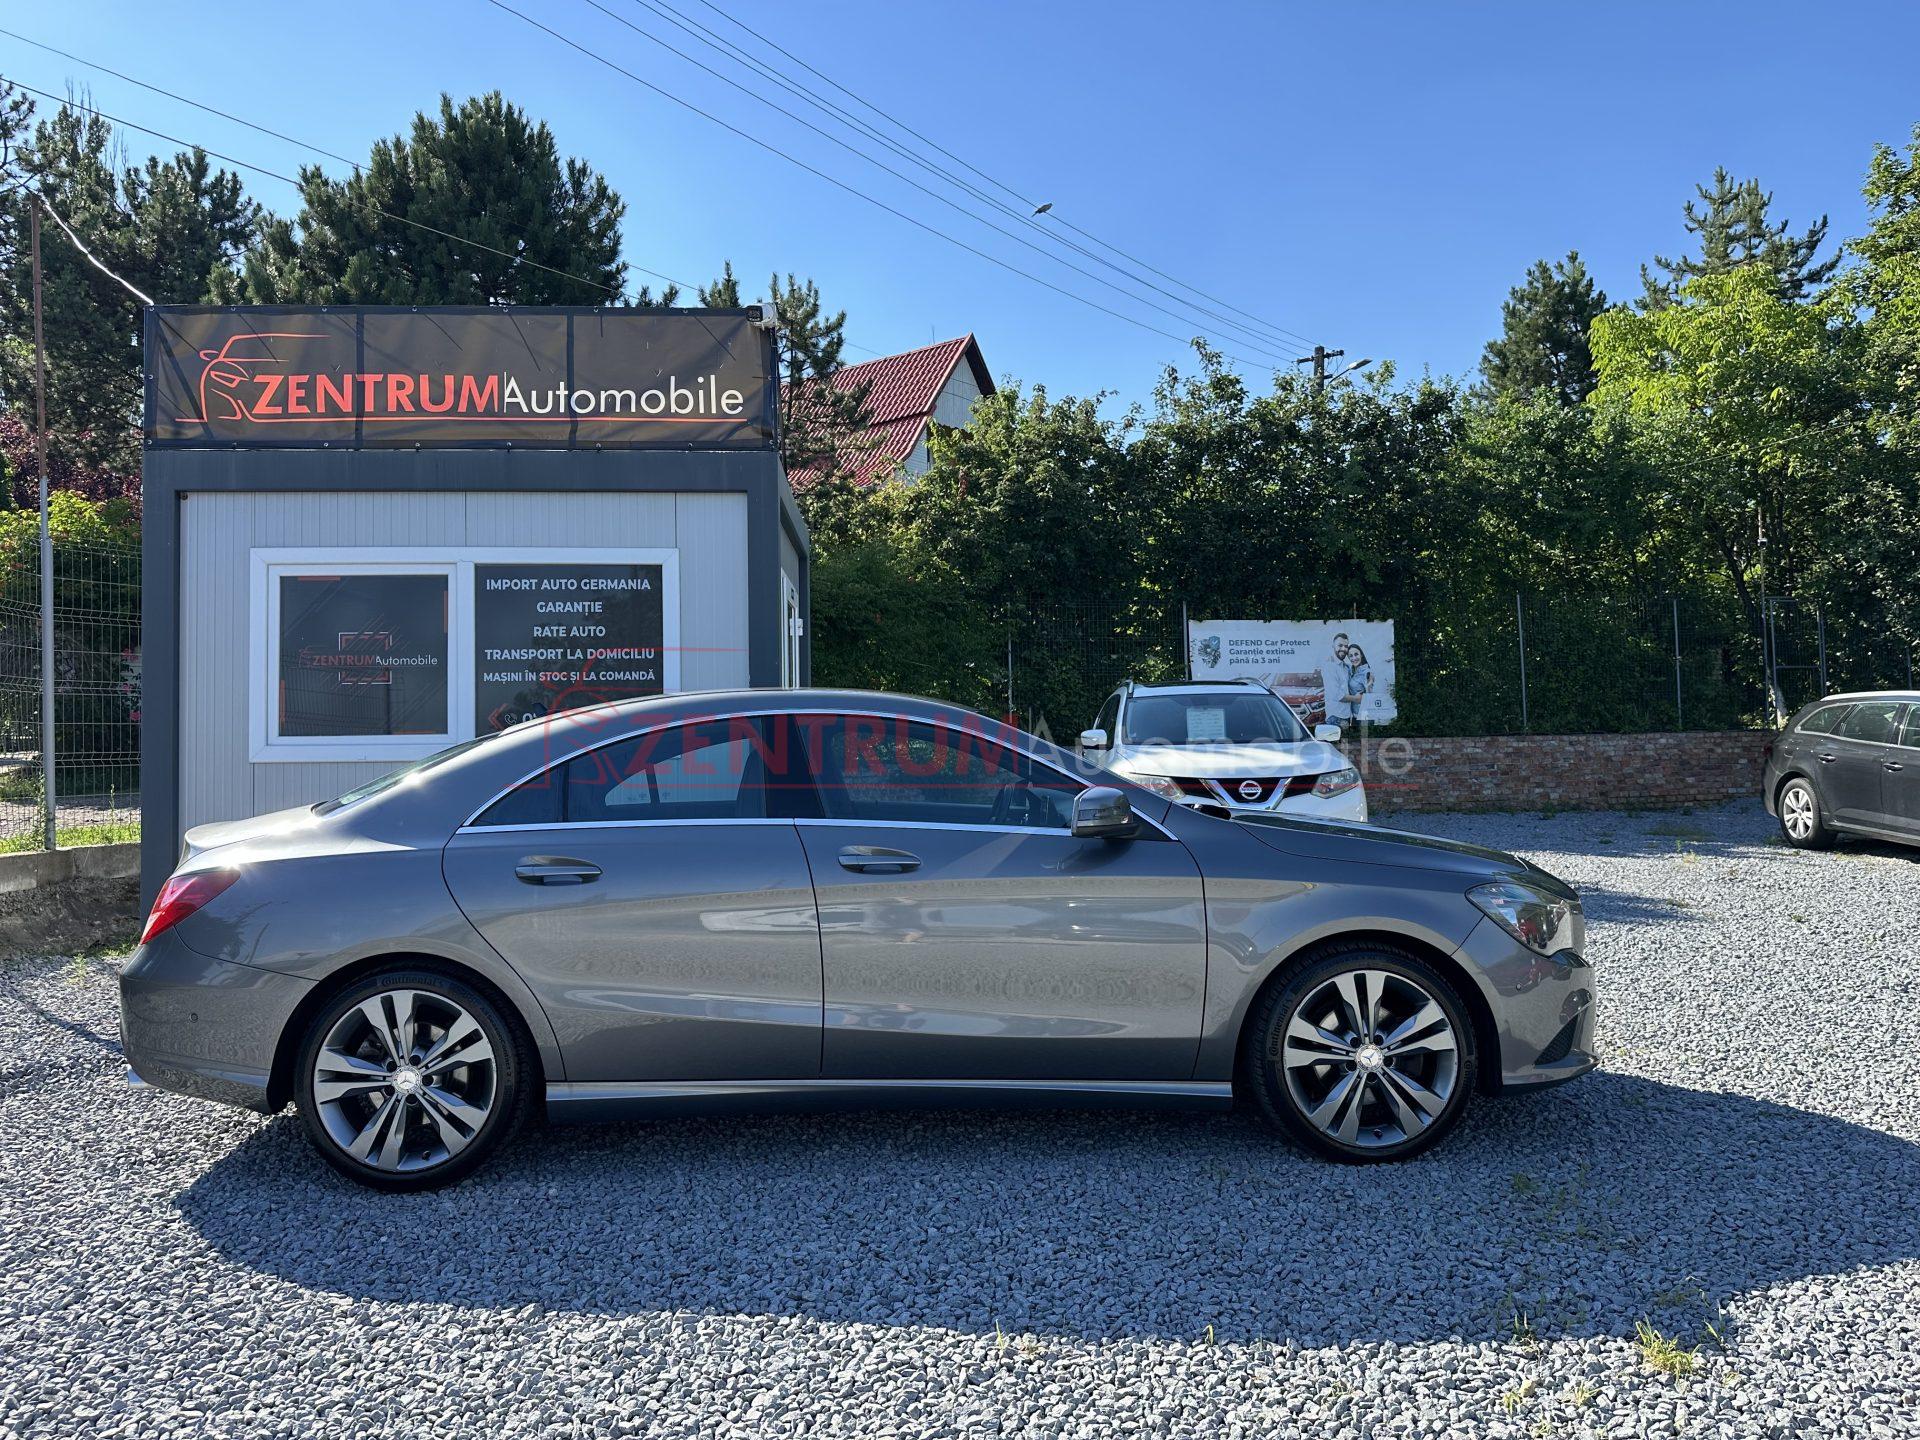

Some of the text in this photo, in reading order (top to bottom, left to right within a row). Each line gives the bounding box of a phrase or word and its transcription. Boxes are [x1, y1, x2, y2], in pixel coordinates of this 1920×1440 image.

[251, 371, 744, 414] ZENTRUM Automobile
[486, 579, 651, 590] IMPORT AUTO GERMANIA
[536, 601, 603, 615] GARANȚIE
[533, 626, 606, 637] RATE AUTO
[312, 654, 438, 666] ZENTRUM Automobile
[484, 648, 655, 660] TRANSPORT LA DOMICILIU
[1267, 656, 1281, 664] ani
[483, 669, 655, 684] MAȘINI ÎN STOC ȘI LA COMANDĂ
